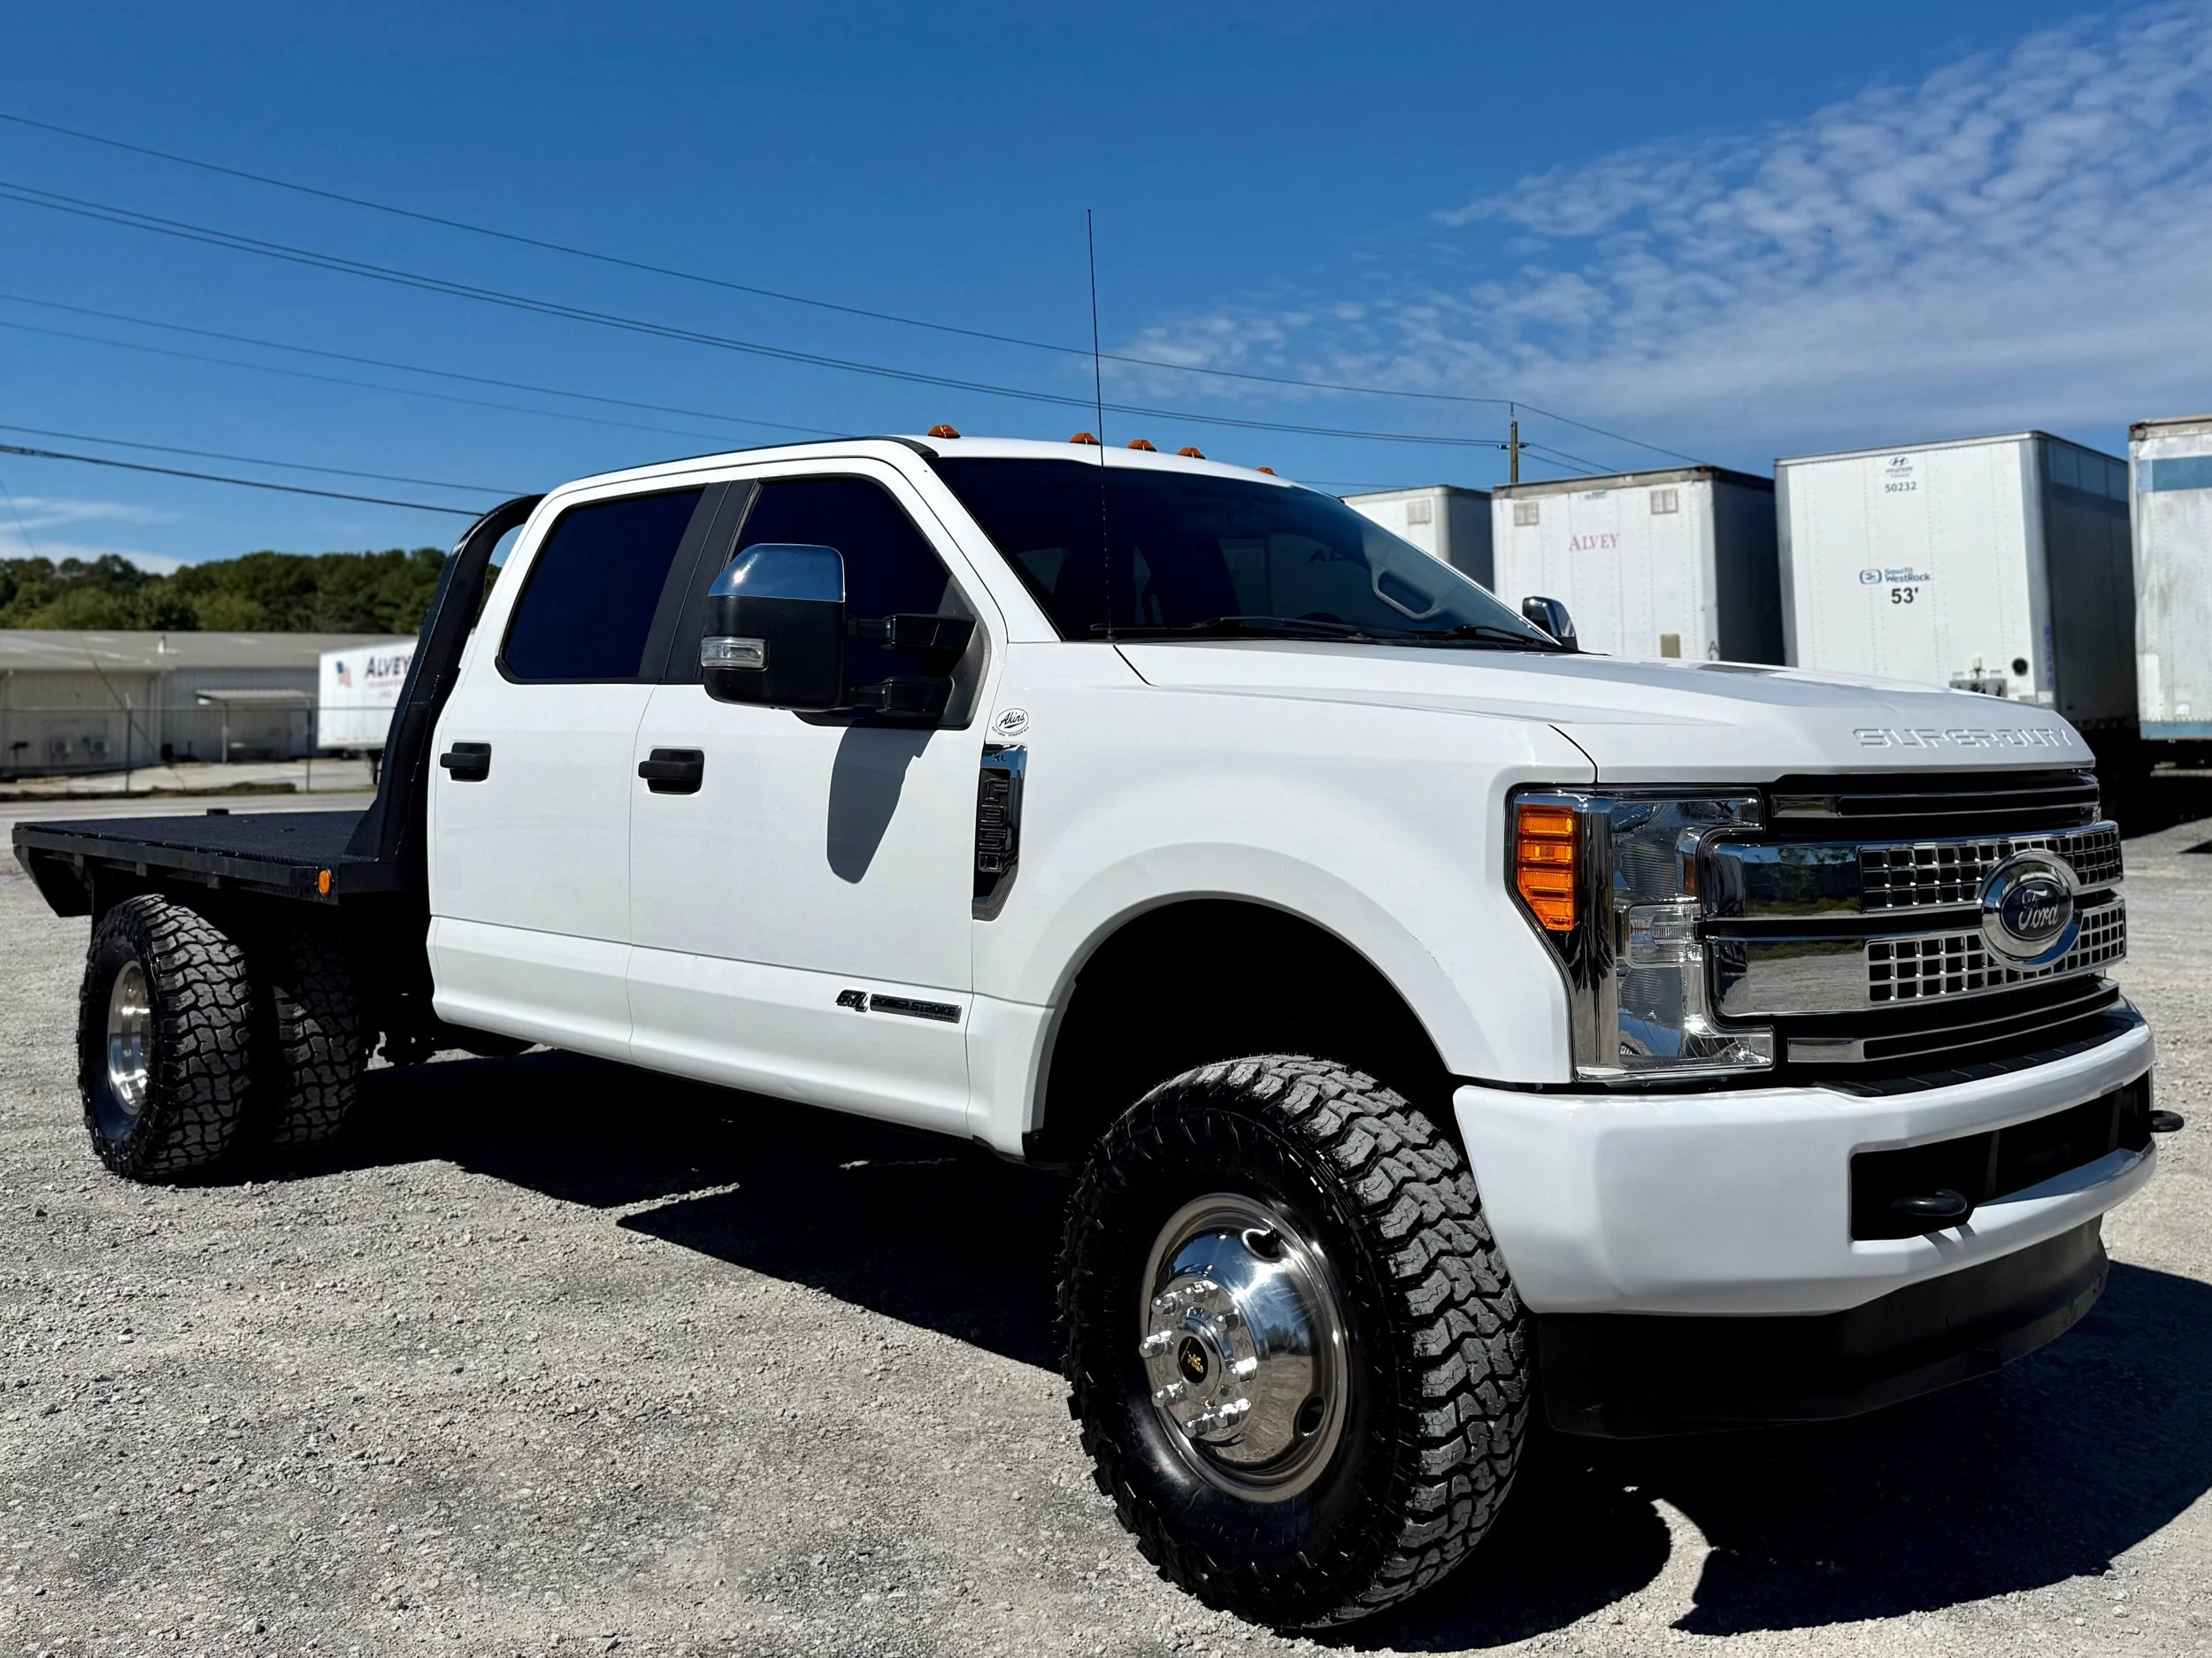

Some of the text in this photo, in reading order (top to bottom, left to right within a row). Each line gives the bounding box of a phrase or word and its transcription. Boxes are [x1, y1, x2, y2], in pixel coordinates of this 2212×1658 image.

[1885, 481, 1917, 493] 50232
[1568, 533, 1620, 551] ALVEY
[1885, 572, 1931, 583] WestRock
[1891, 587, 1919, 604] 53'
[365, 655, 412, 679] ALVEY
[998, 711, 1025, 728] Akins
[2018, 889, 2059, 931] Ford
[910, 1001, 956, 1017] STROKE
